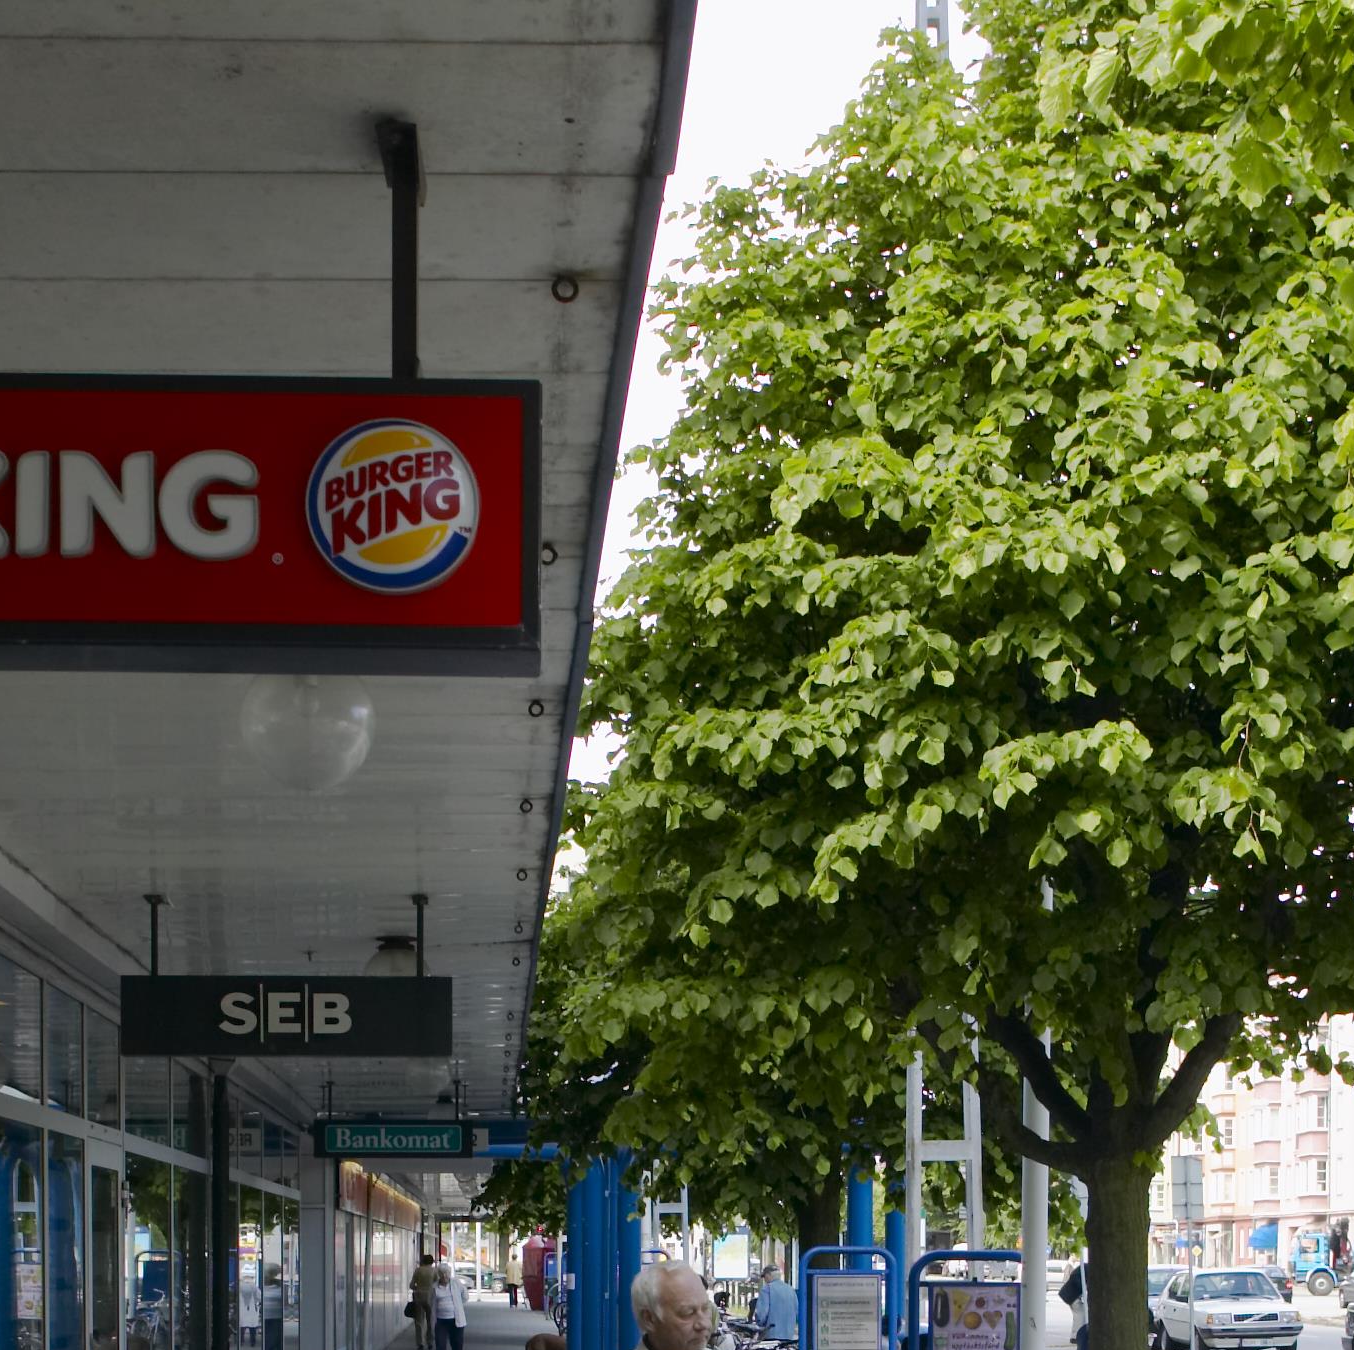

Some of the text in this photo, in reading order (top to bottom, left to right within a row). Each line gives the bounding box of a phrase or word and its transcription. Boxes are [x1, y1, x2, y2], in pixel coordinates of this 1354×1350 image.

[325, 451, 455, 513] BURGER
[331, 478, 461, 558] KING
[335, 1127, 451, 1149] Bankomat
